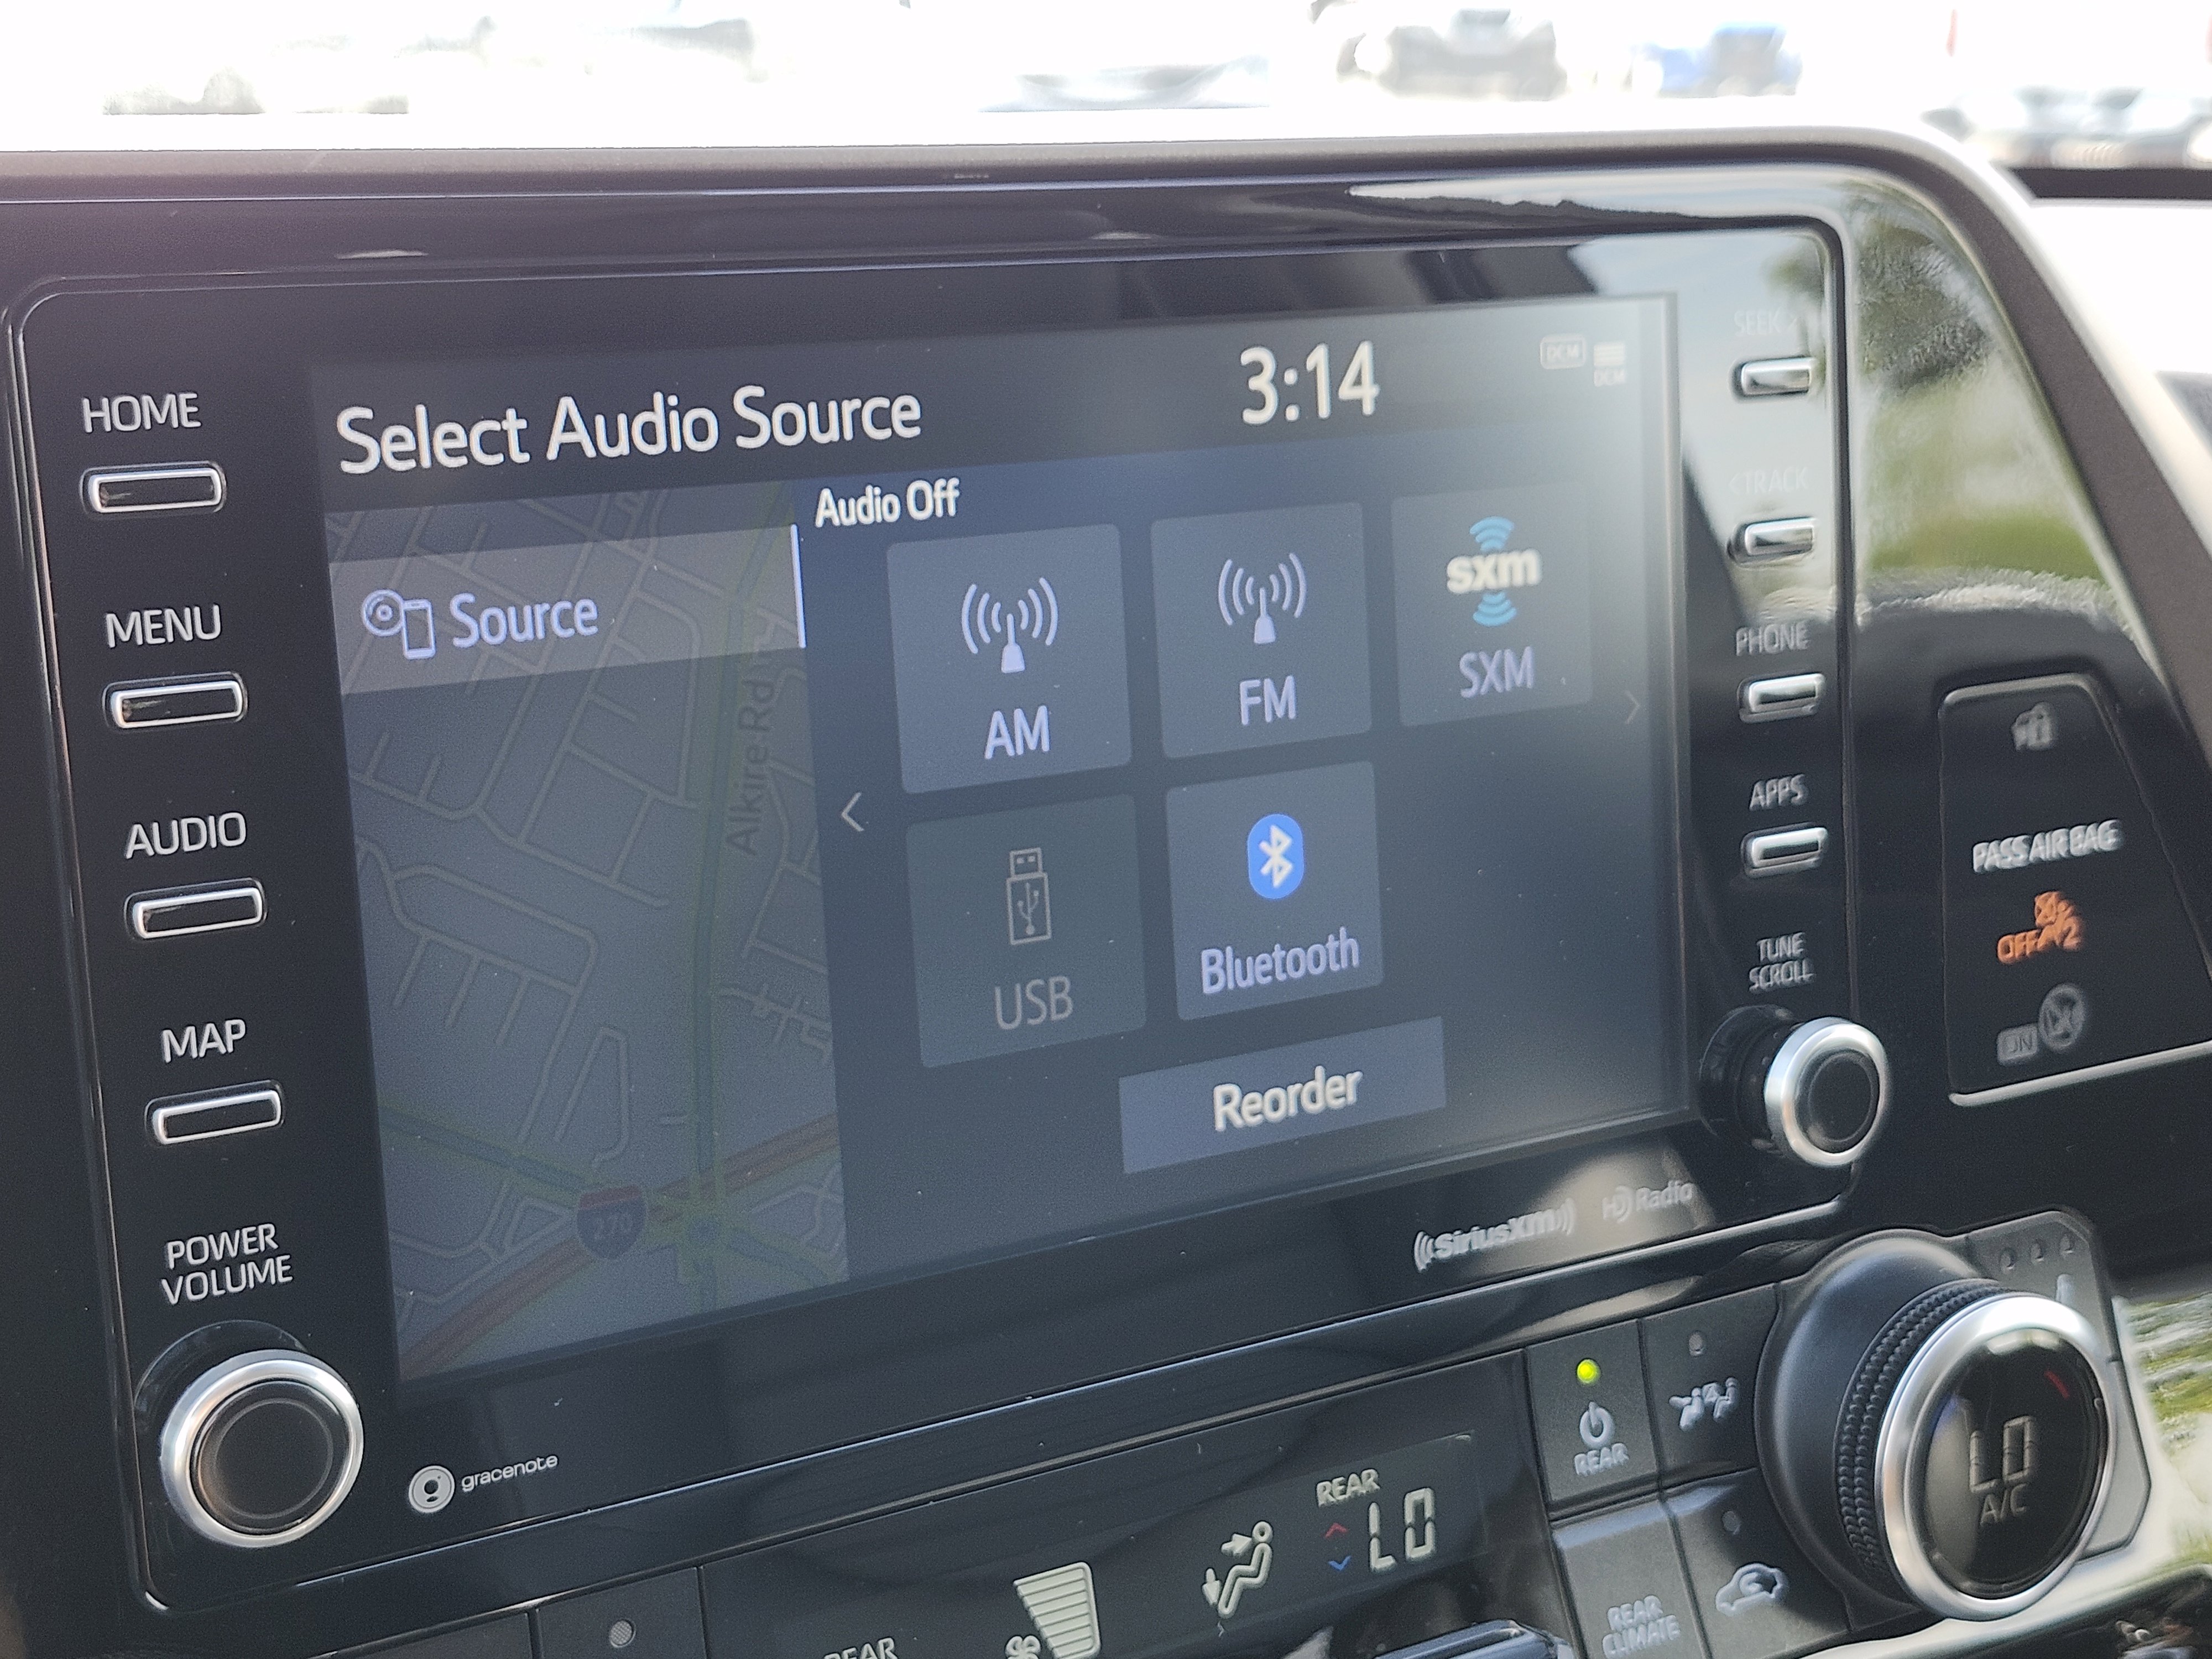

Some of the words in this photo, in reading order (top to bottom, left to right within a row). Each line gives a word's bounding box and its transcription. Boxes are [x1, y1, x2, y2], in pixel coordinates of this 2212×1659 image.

[1240, 340, 1380, 425] 3:14
[82, 393, 201, 433] HOME
[336, 405, 530, 474] Select
[546, 390, 719, 460] Audio
[733, 385, 922, 448] Source
[815, 487, 900, 528] Audio
[906, 477, 960, 520] Off
[1447, 548, 1541, 594] sxm
[105, 604, 221, 648] MENU
[448, 592, 599, 648] Source
[1735, 621, 1809, 657] PHONE
[1459, 645, 1535, 698] SXM
[740, 679, 774, 733] Rd
[1238, 674, 1297, 726] FM
[984, 706, 1051, 760] AM
[726, 745, 769, 857] Alkire
[1748, 774, 1808, 811] APPS
[124, 811, 247, 859] AUDIO
[1972, 834, 2032, 874] PASS
[2028, 827, 2070, 864] AIR
[2069, 818, 2124, 858] BAG
[1201, 926, 1360, 995] Bluetooth
[1756, 931, 1807, 963] TUNE
[1997, 929, 2041, 964] OFF
[1749, 957, 1816, 995] SCROLL
[995, 975, 1074, 1031] USB
[162, 1019, 247, 1063] MAP
[1214, 1066, 1363, 1131] Reorder
[1635, 1180, 1695, 1212] Radio
[166, 1223, 279, 1270] POWER
[161, 1254, 294, 1305] VOLUME
[461, 1454, 559, 1492] gracenote
[1574, 1442, 1630, 1477] REAR
[1316, 1469, 1380, 1507] REAR
[1980, 1484, 2028, 1526] A/C
[1607, 1595, 1664, 1631] REAR
[1603, 1614, 1681, 1659] CLIMATE
